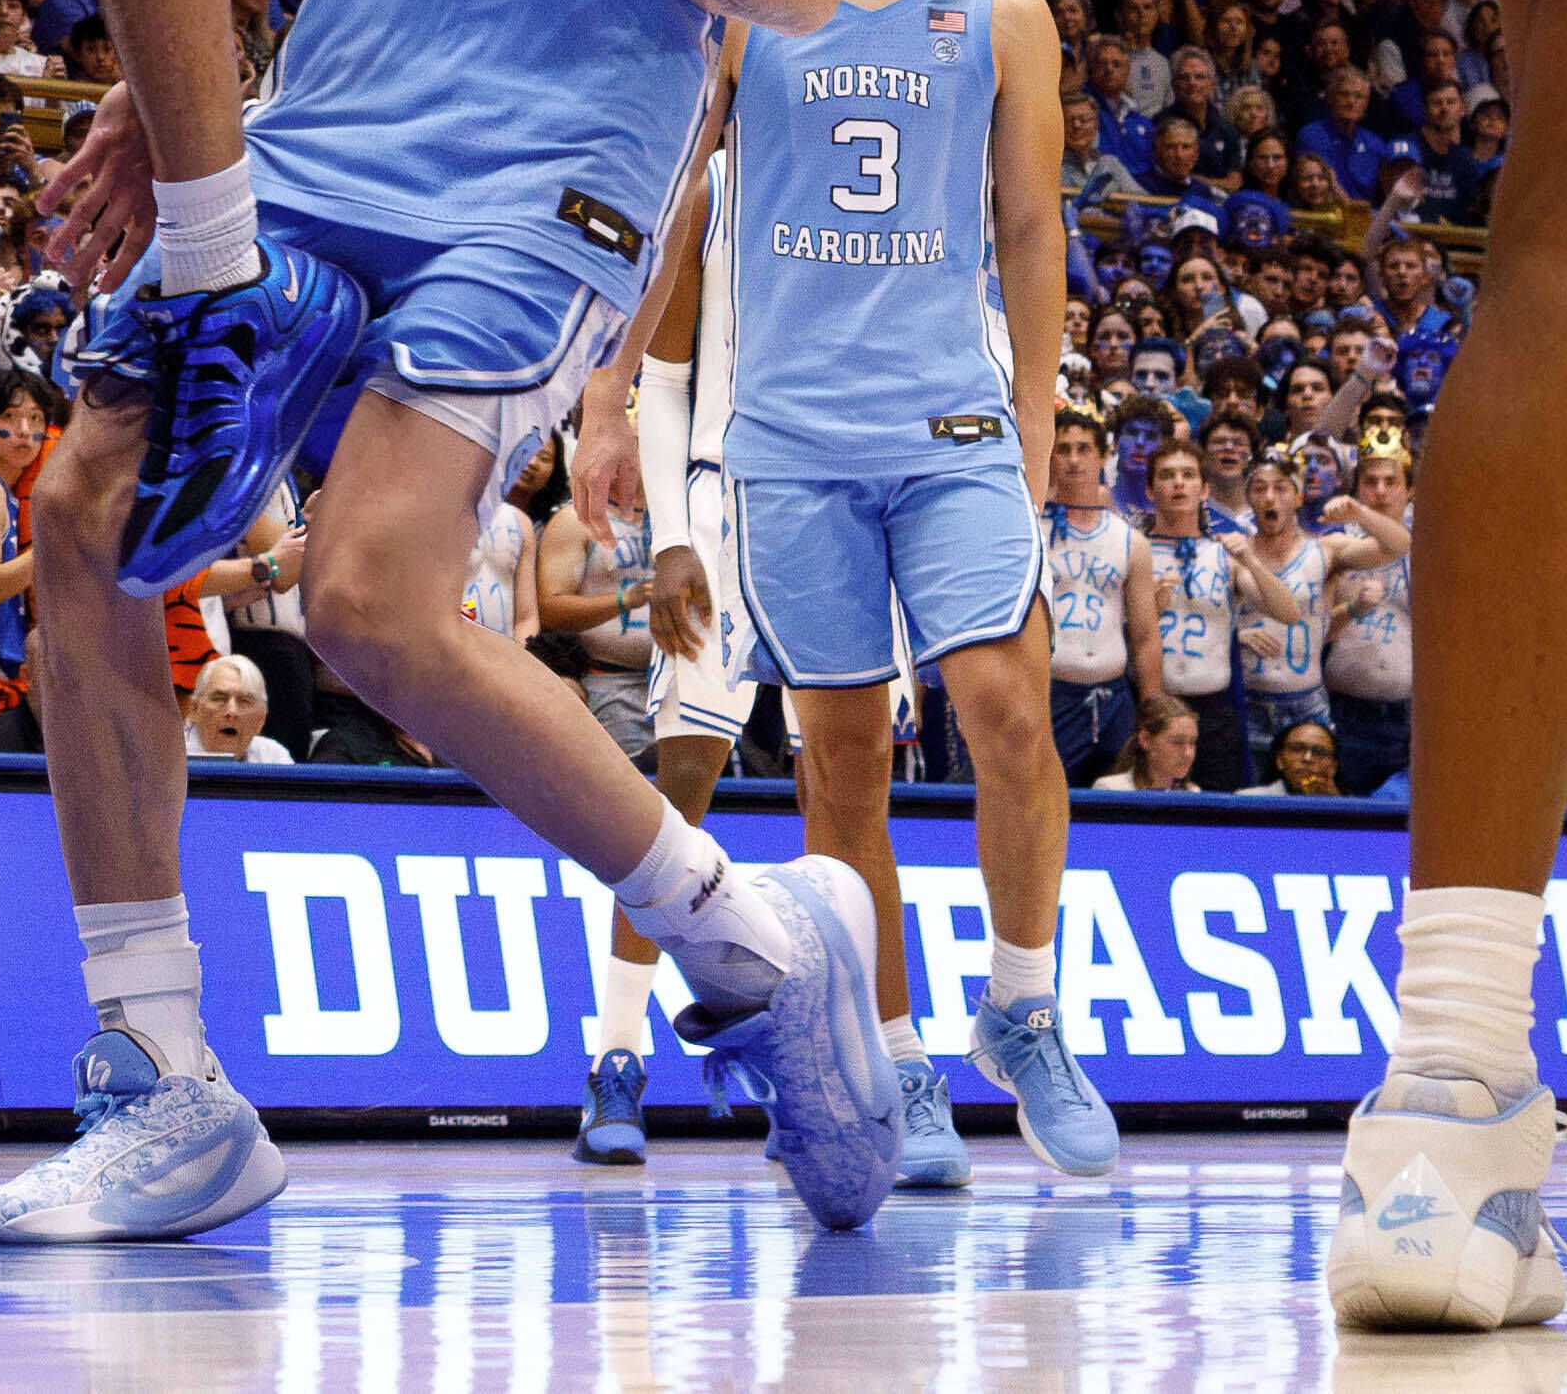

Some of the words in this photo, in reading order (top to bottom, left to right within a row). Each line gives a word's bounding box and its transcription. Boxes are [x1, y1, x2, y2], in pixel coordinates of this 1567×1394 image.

[803, 63, 931, 109] NORTH
[831, 117, 902, 213] 3
[772, 222, 946, 266] CAROLINA
[1055, 592, 1104, 632] 25
[428, 1115, 509, 1128] DAKTRONICS
